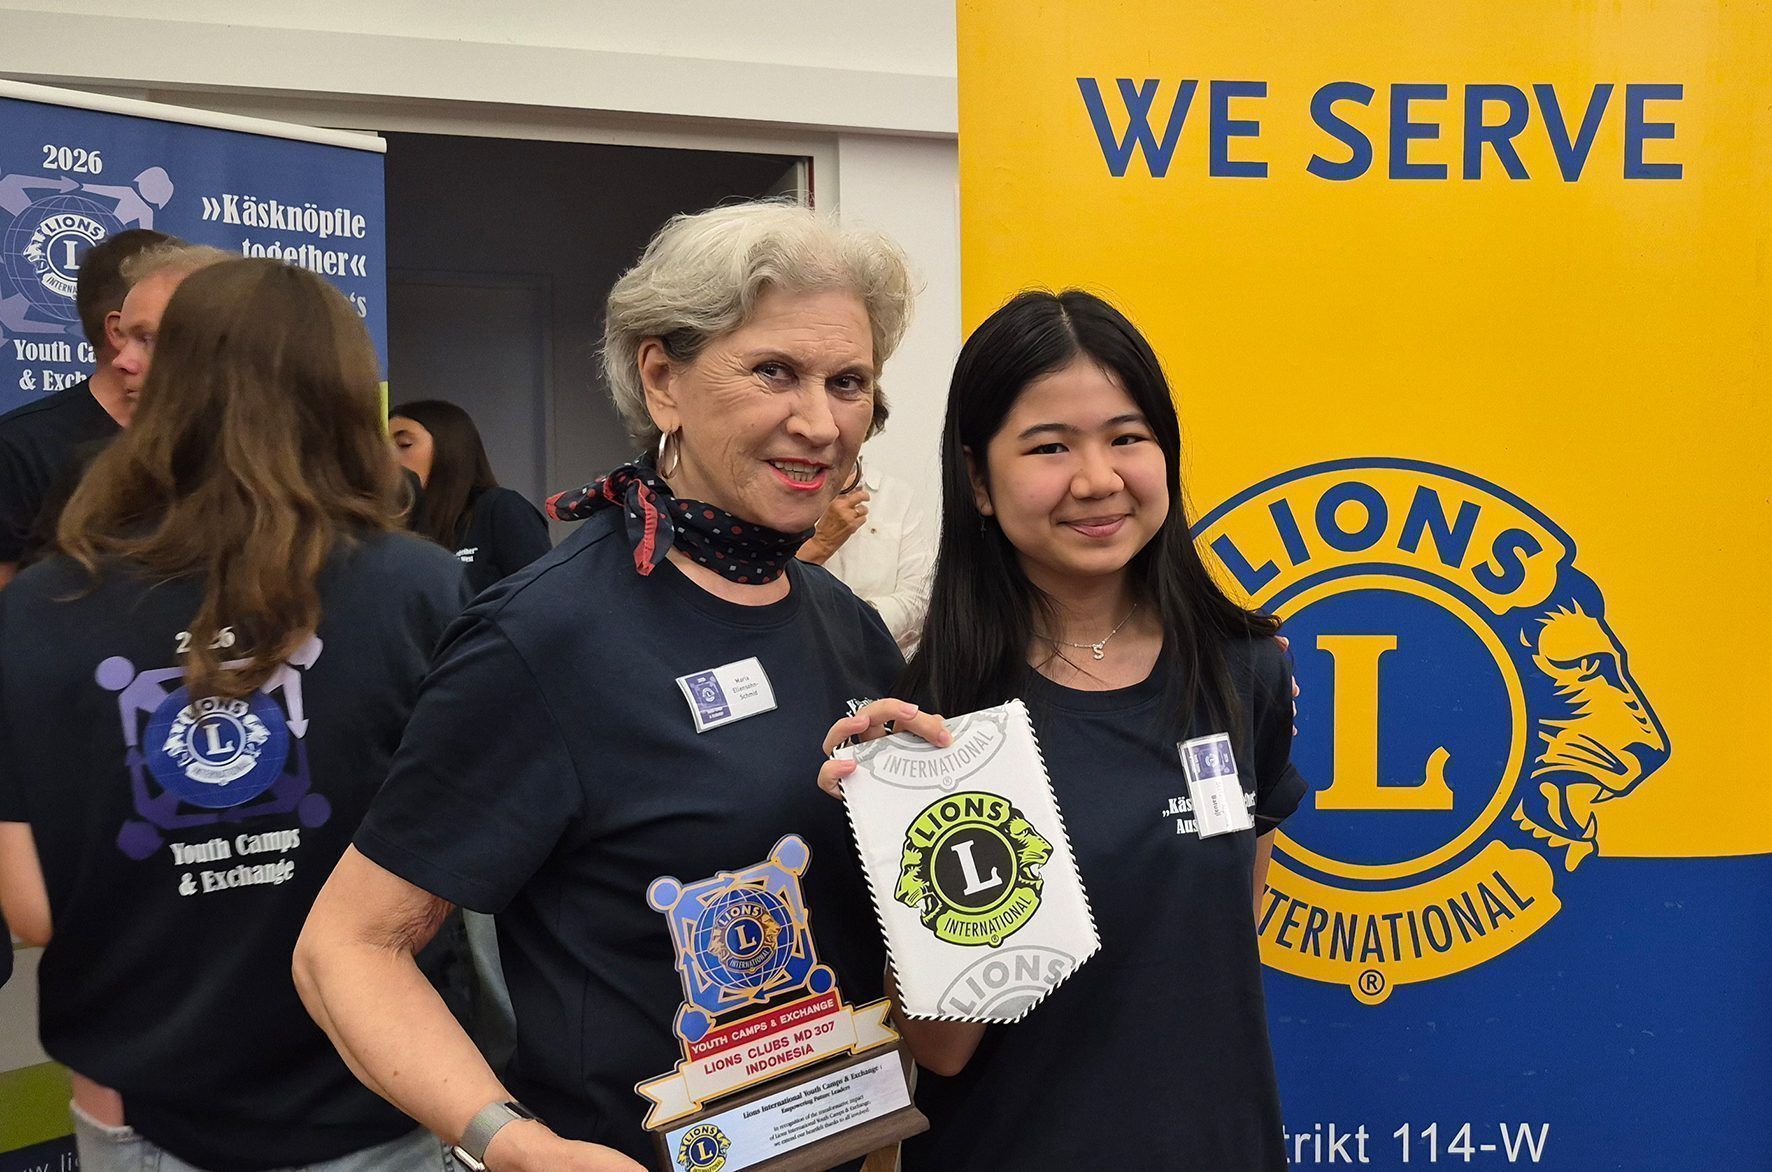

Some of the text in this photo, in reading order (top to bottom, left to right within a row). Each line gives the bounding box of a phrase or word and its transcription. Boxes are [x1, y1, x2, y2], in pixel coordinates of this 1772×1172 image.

[1076, 77, 1684, 182] WE SERVE
[42, 144, 103, 174] 2026
[45, 217, 101, 237] LIONS
[202, 194, 366, 238] »Käsknöpfle
[13, 339, 97, 363] Youth Ca
[19, 369, 88, 391] & Exch
[1211, 480, 1543, 597] LIONS
[175, 626, 235, 654] 26
[1315, 634, 1454, 810] L
[203, 723, 235, 755] L
[882, 730, 994, 778] INTERNATIONAL
[915, 798, 1005, 841] LIONS
[1162, 796, 1193, 817] „Käs
[1176, 818, 1199, 835] Aus
[169, 828, 301, 865] Youth Camps
[178, 858, 295, 897] & Exchange
[951, 839, 1003, 896] L
[719, 905, 760, 926] LIONS
[943, 896, 1032, 937] INTERNATIONAL
[1257, 870, 1536, 964] TERNATIONAL
[734, 924, 757, 950] L
[729, 949, 770, 969] INTERNATIONAL
[949, 953, 1067, 1015] LIONS
[691, 1000, 835, 1055] YOUTH CAMPS & EXCHANGE
[704, 1020, 836, 1075] LIONS CLUBS MD 307
[745, 1043, 815, 1076] INDONESIA
[743, 1109, 761, 1119] Lions
[761, 1092, 803, 1112] International
[803, 1085, 822, 1096] Youth
[822, 1078, 843, 1090] Camps
[844, 1075, 850, 1083] &
[850, 1066, 879, 1080] Exchange
[781, 1085, 850, 1114] Empowering Future Leaders
[685, 1126, 716, 1142] LIONS
[775, 1131, 787, 1139] Lions
[787, 1119, 816, 1134] International
[829, 1110, 845, 1119] Camps
[780, 1117, 805, 1130] recognition
[696, 1141, 714, 1161] L
[1282, 1122, 1551, 1164] rikt 114-W
